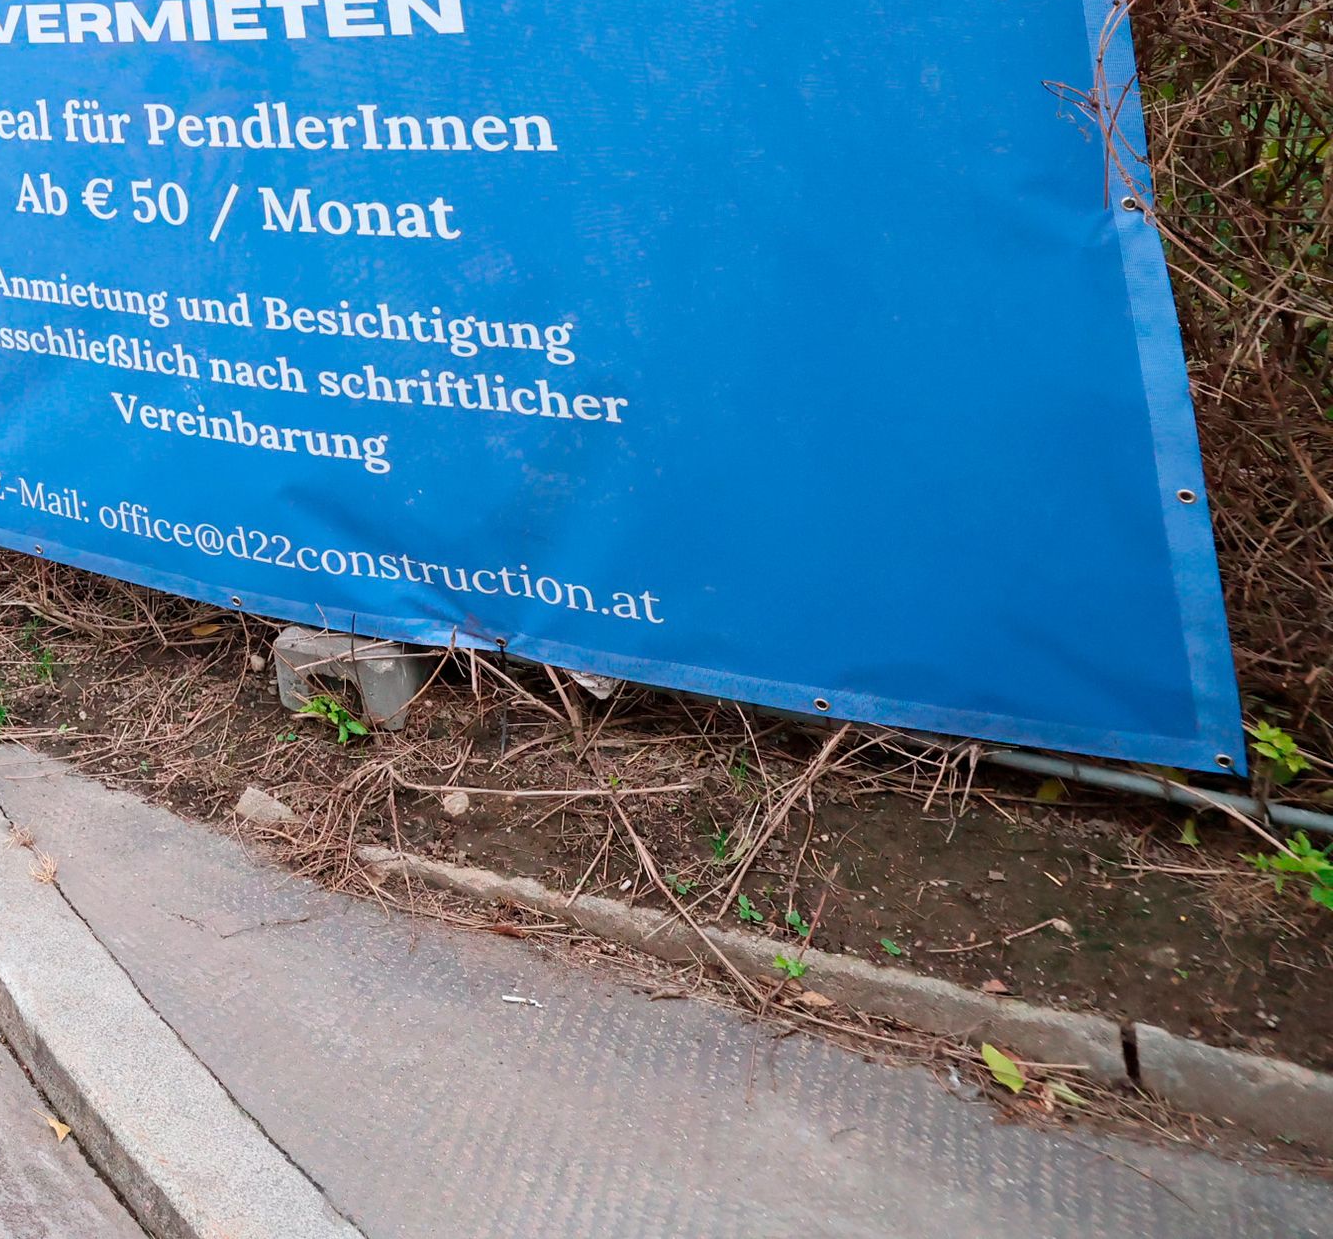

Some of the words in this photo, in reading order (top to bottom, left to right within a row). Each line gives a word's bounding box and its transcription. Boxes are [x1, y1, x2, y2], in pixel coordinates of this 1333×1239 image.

[62, 99, 131, 145] für
[144, 102, 558, 152] PendlerInnen
[15, 172, 69, 216] Ab
[81, 178, 119, 220] €
[132, 178, 189, 226] 50
[258, 187, 462, 240] Monat
[177, 292, 253, 327] und
[263, 297, 576, 365] Besichtigung
[209, 356, 308, 393] nach
[318, 365, 629, 424] schriftlicher
[111, 392, 391, 474] Vereinbarung
[98, 501, 665, 625] office@d22construction.at
